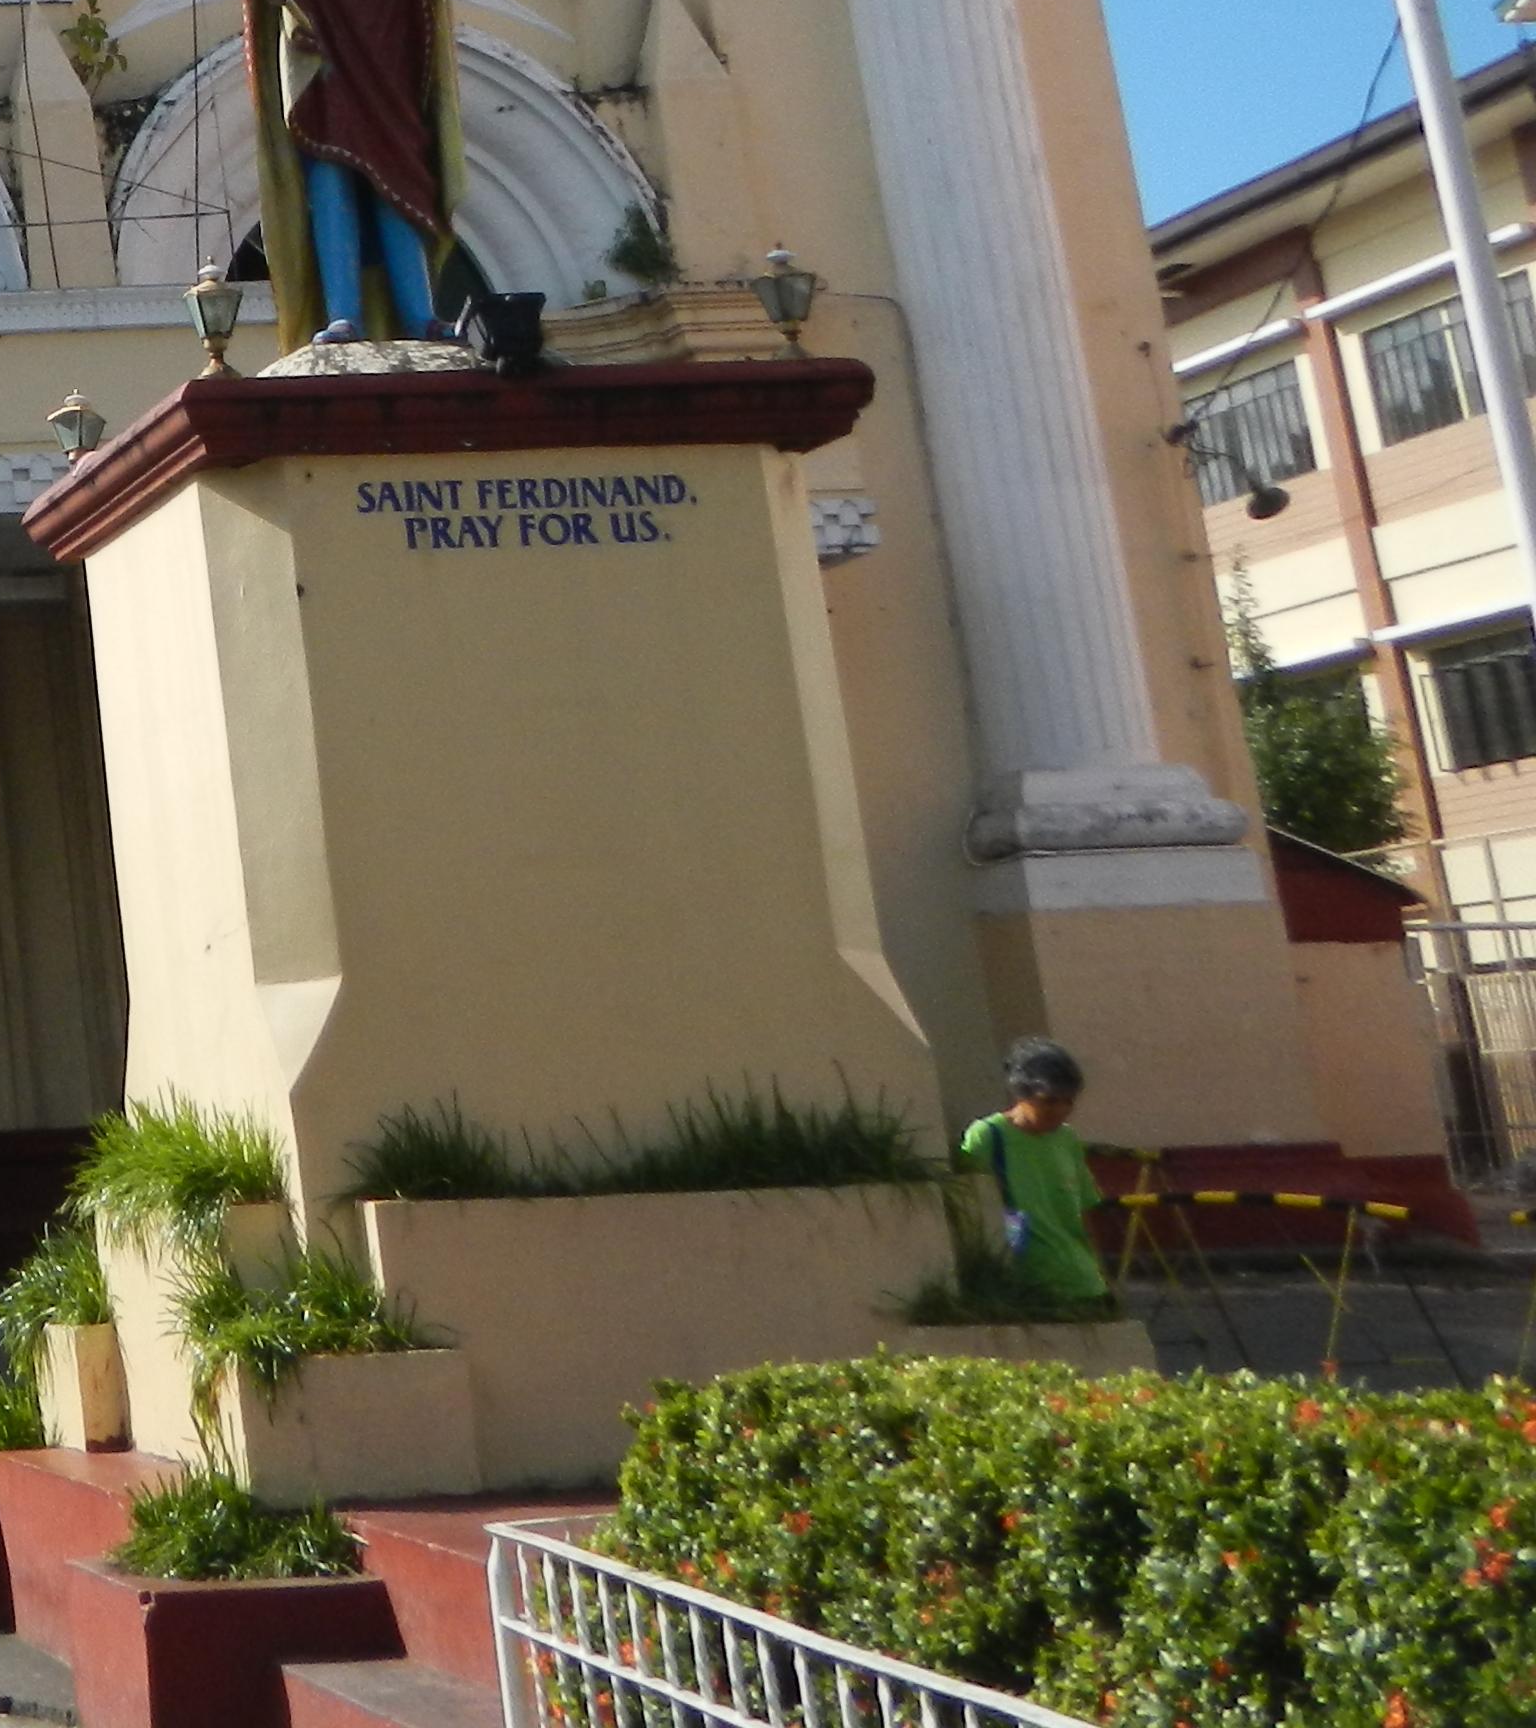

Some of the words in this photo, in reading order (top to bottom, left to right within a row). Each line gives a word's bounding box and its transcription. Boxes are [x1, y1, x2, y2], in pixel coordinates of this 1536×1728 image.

[356, 479, 463, 513] SAINT
[477, 474, 698, 510] FERDINAND.
[404, 515, 503, 550] PRAY
[518, 511, 599, 547] FOR
[609, 509, 672, 544] US.
